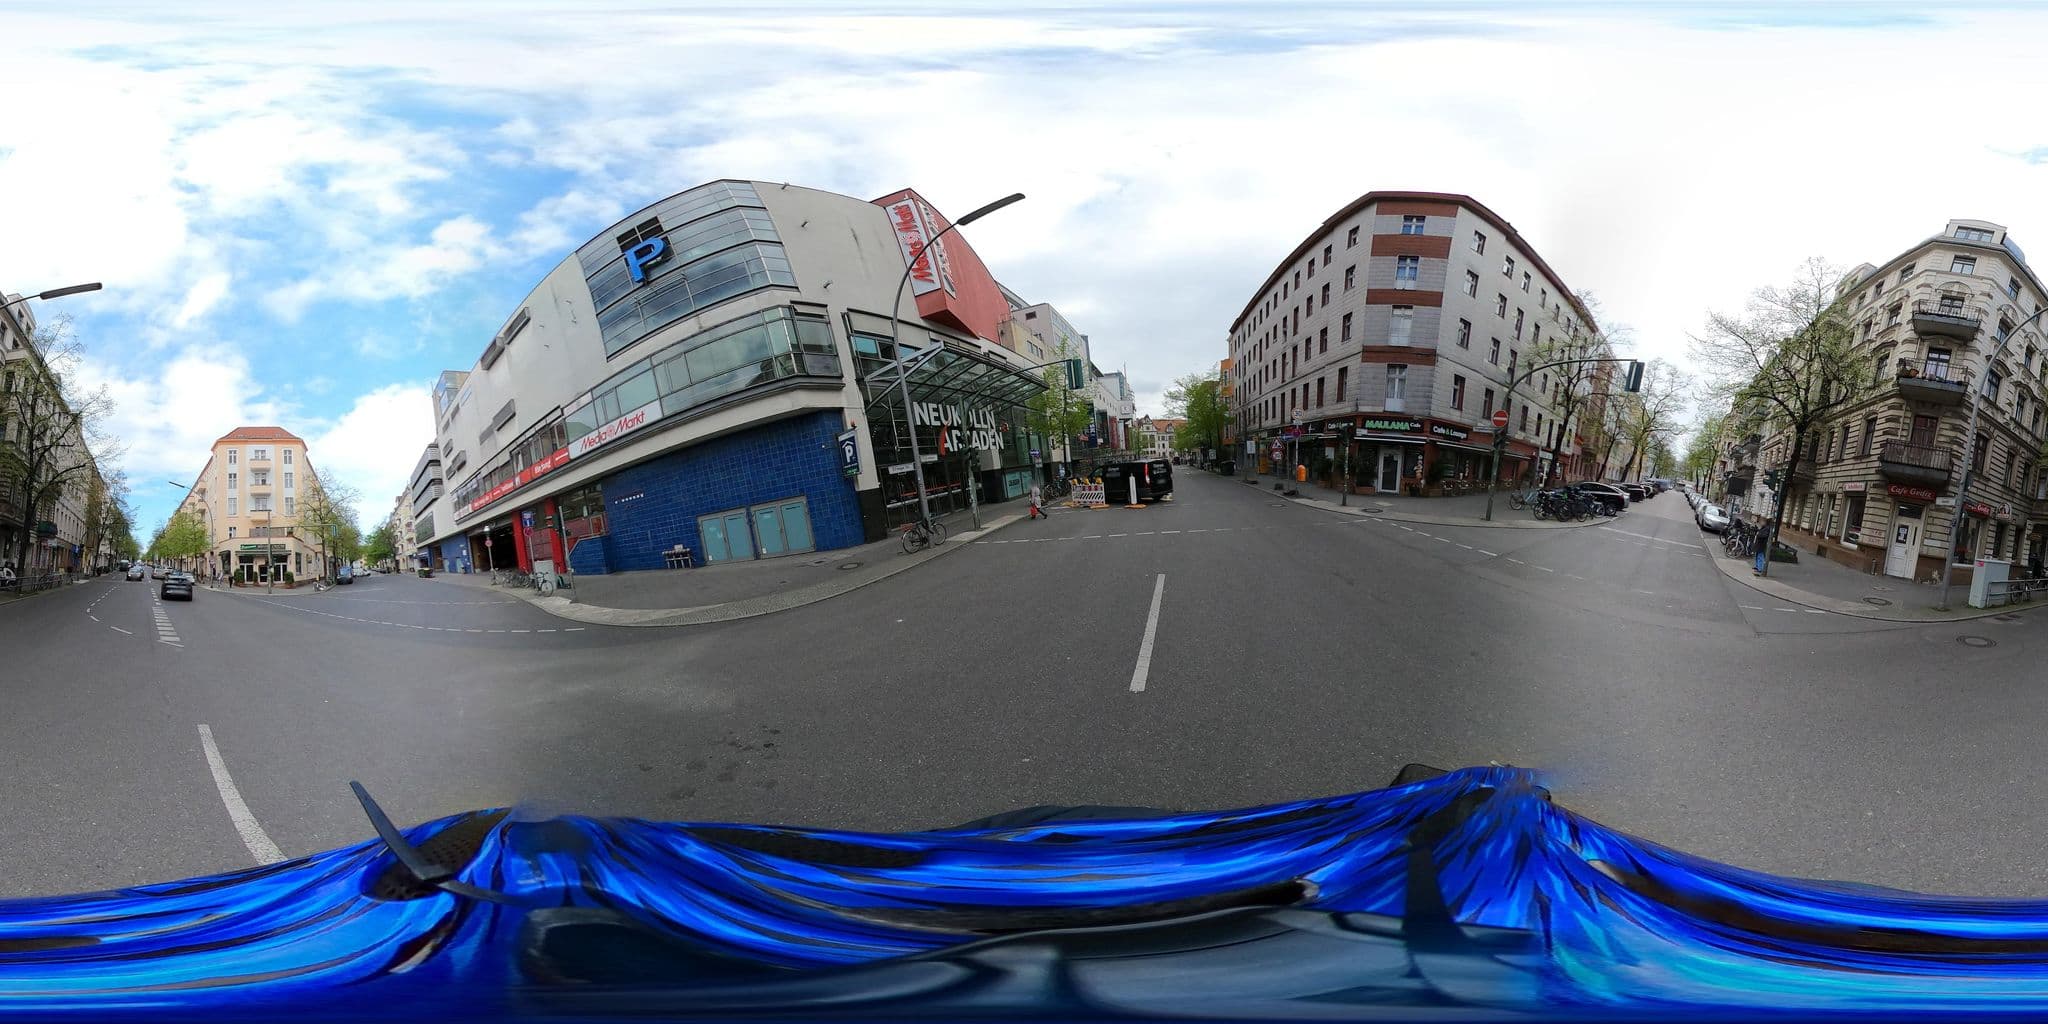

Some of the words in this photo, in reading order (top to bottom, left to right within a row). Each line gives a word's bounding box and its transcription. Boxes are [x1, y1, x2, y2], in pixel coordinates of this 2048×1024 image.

[624, 236, 667, 284] P
[913, 401, 996, 431] NEUKLLN
[1365, 420, 1411, 431] MAULANA
[845, 445, 853, 462] P
[1890, 485, 1908, 494] Cafe
